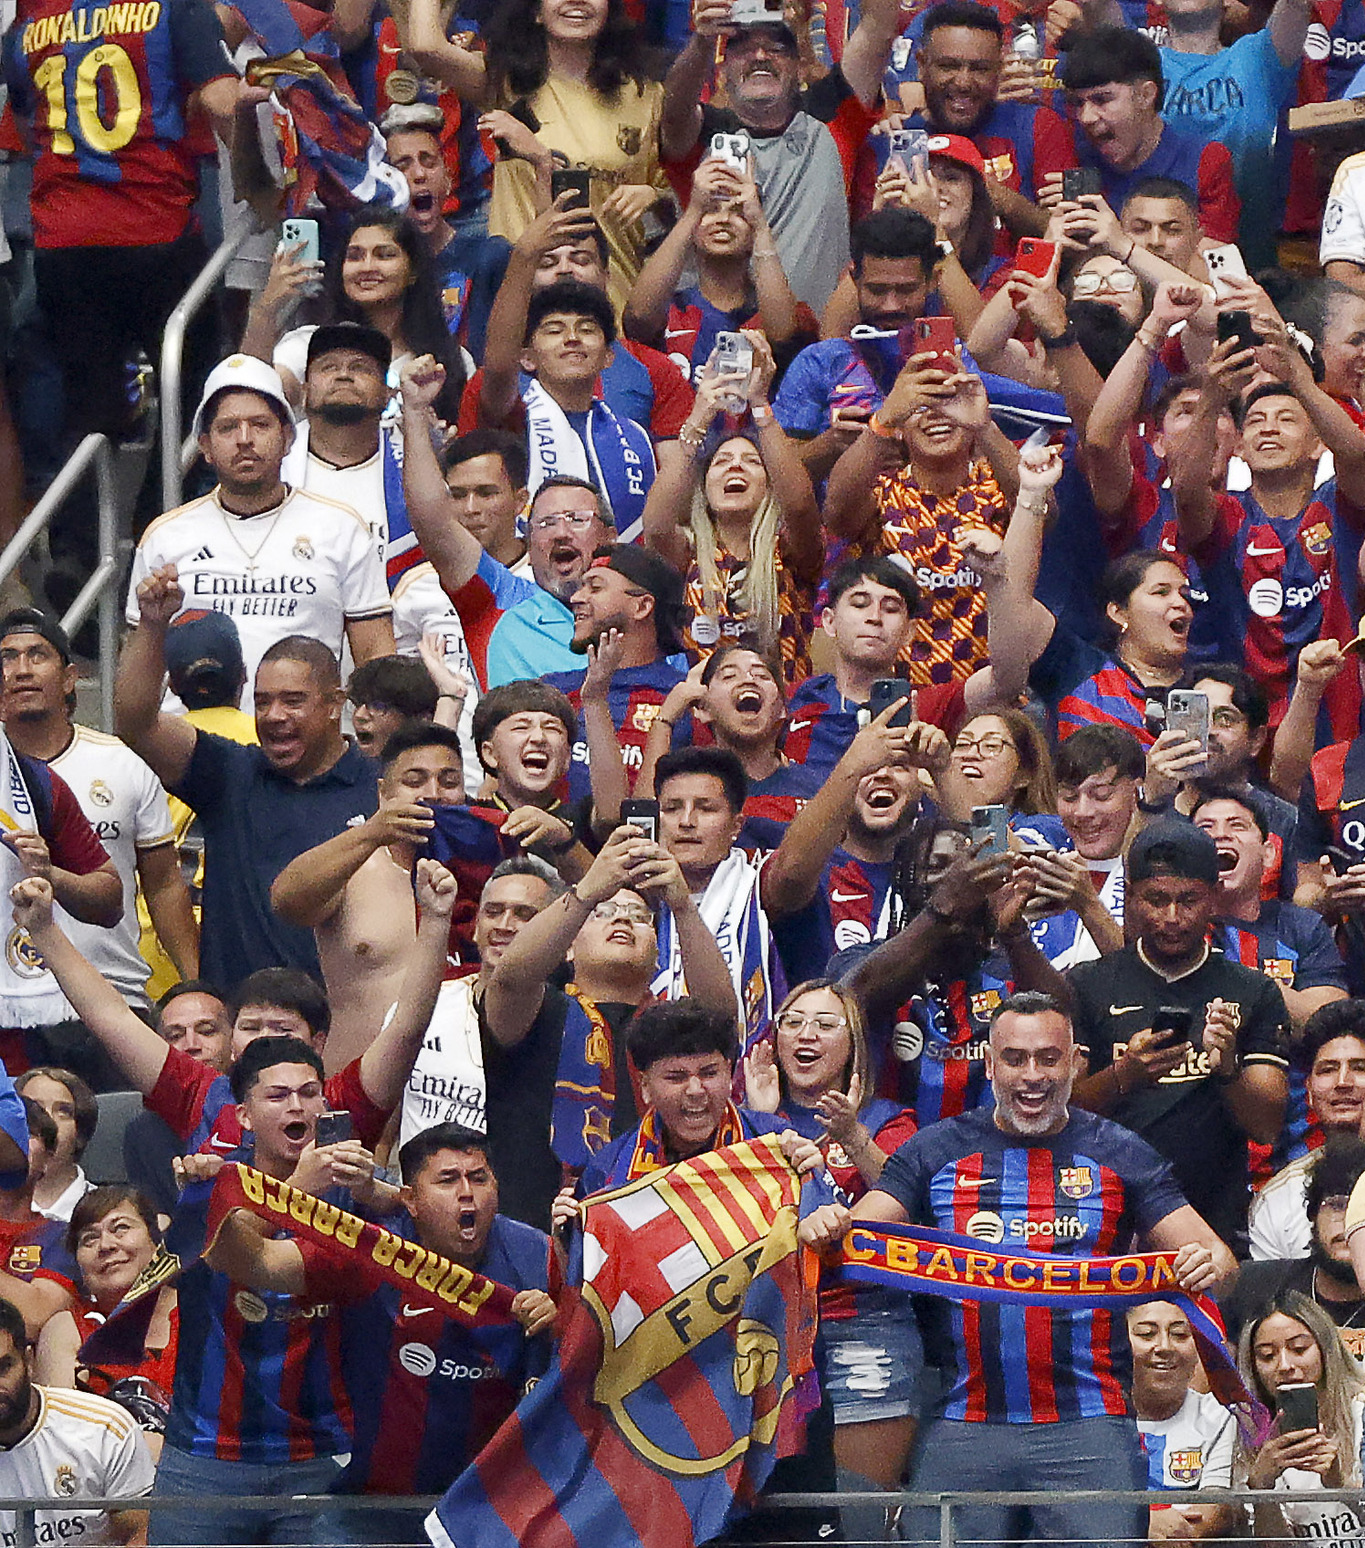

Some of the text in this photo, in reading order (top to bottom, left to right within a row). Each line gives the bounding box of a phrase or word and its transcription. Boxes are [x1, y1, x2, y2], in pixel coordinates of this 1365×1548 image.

[23, 1, 160, 54] RONALDINHO
[38, 42, 142, 154] 10
[194, 572, 318, 598] Emirates
[241, 598, 298, 618] BETTER
[97, 820, 120, 841] es
[1009, 1215, 1091, 1243] Spotify
